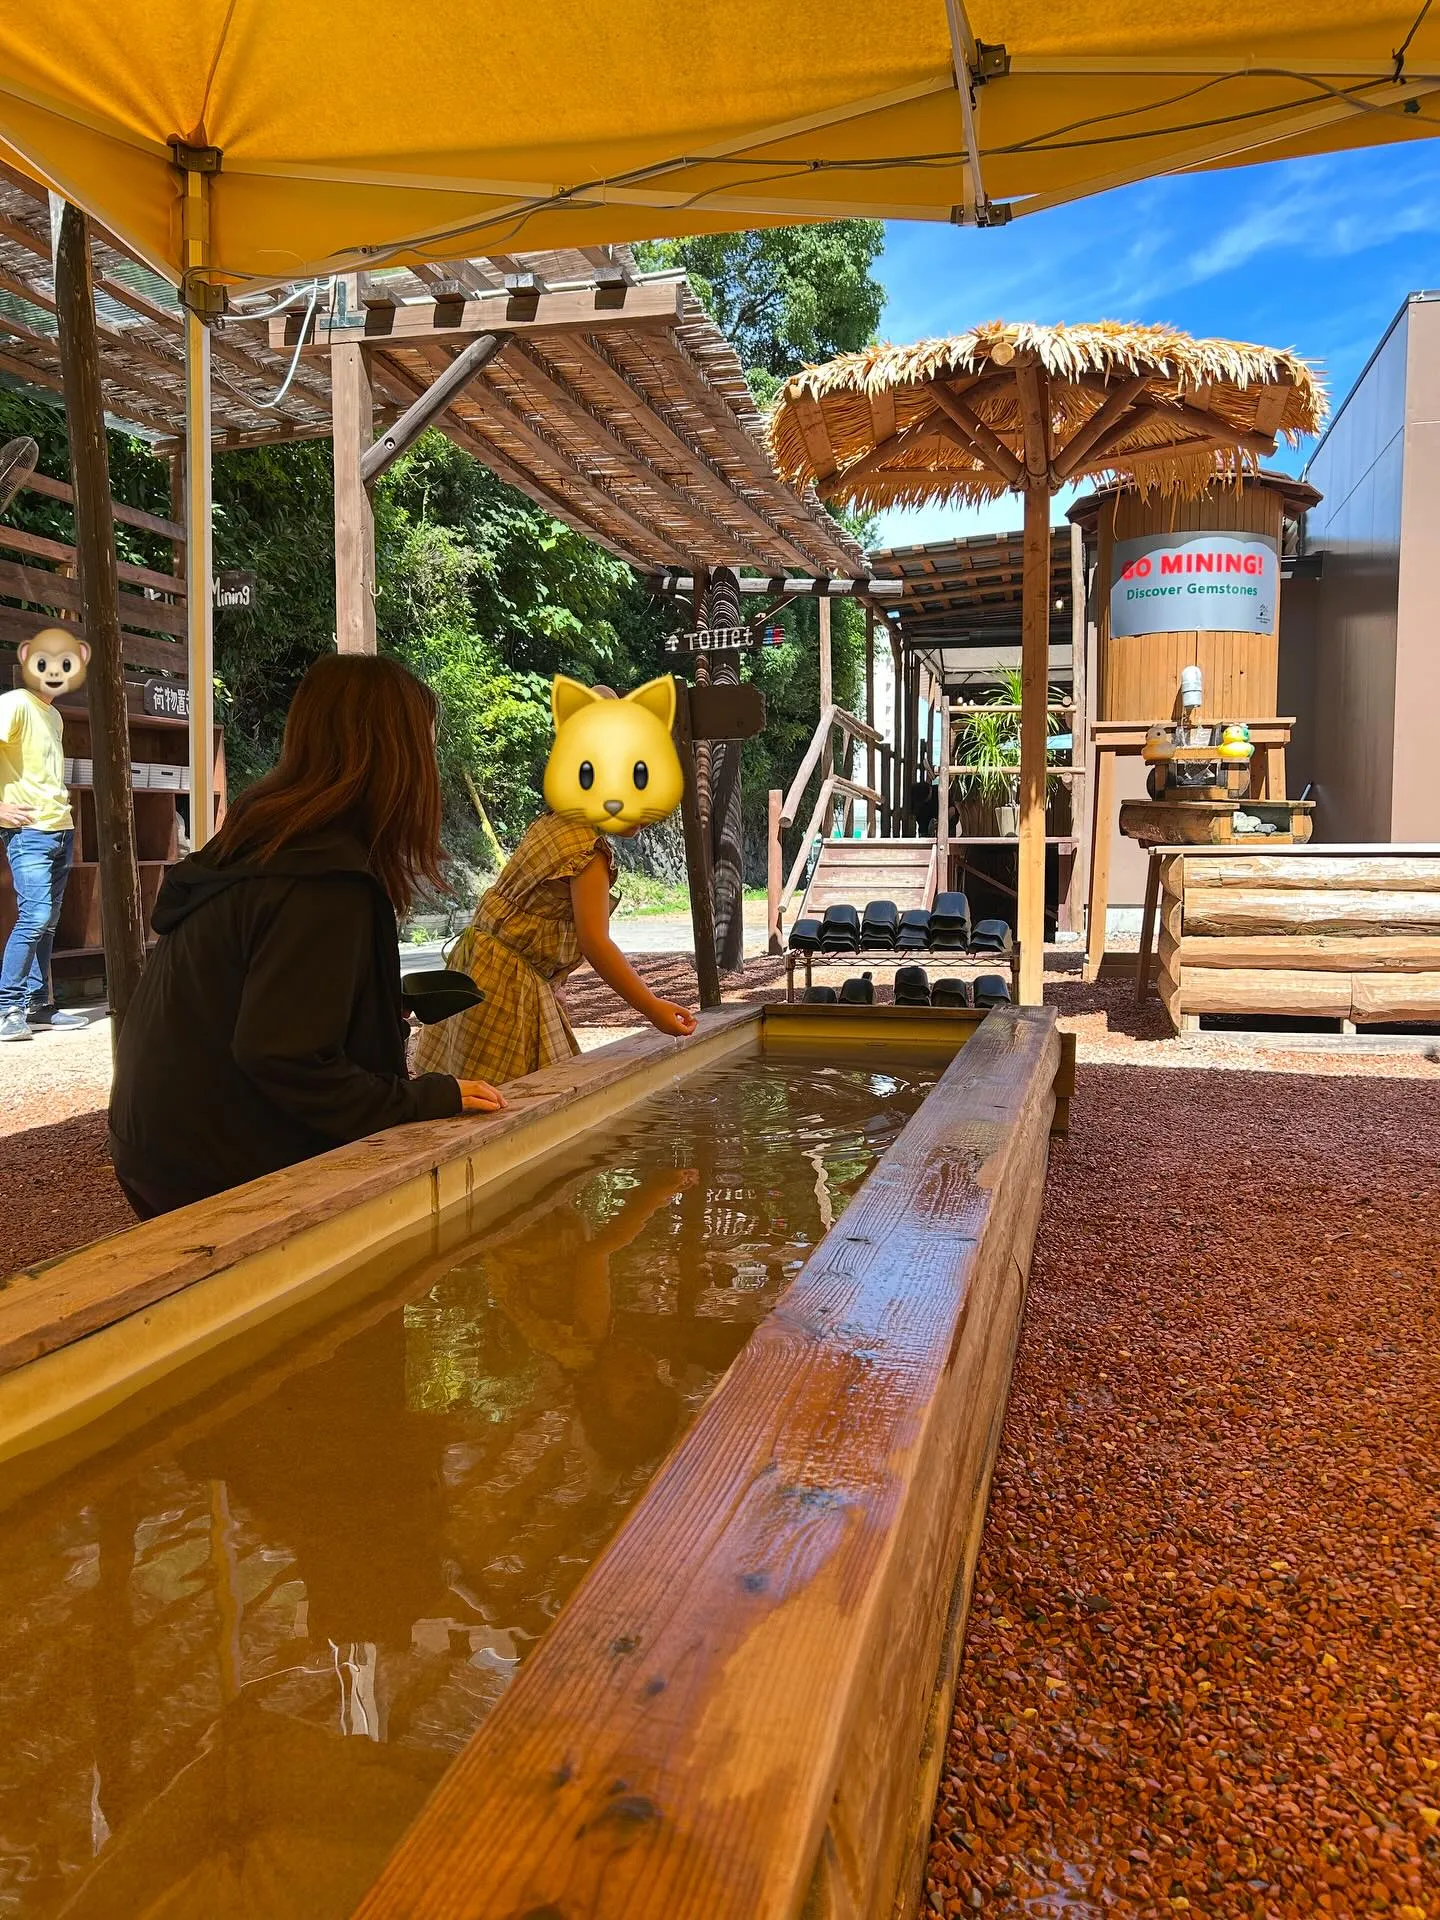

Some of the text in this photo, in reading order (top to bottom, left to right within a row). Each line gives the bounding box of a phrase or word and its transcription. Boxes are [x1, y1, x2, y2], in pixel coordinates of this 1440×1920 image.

[1121, 553, 1264, 580] GO MINING!
[1126, 583, 1258, 600] Discover Gemstones
